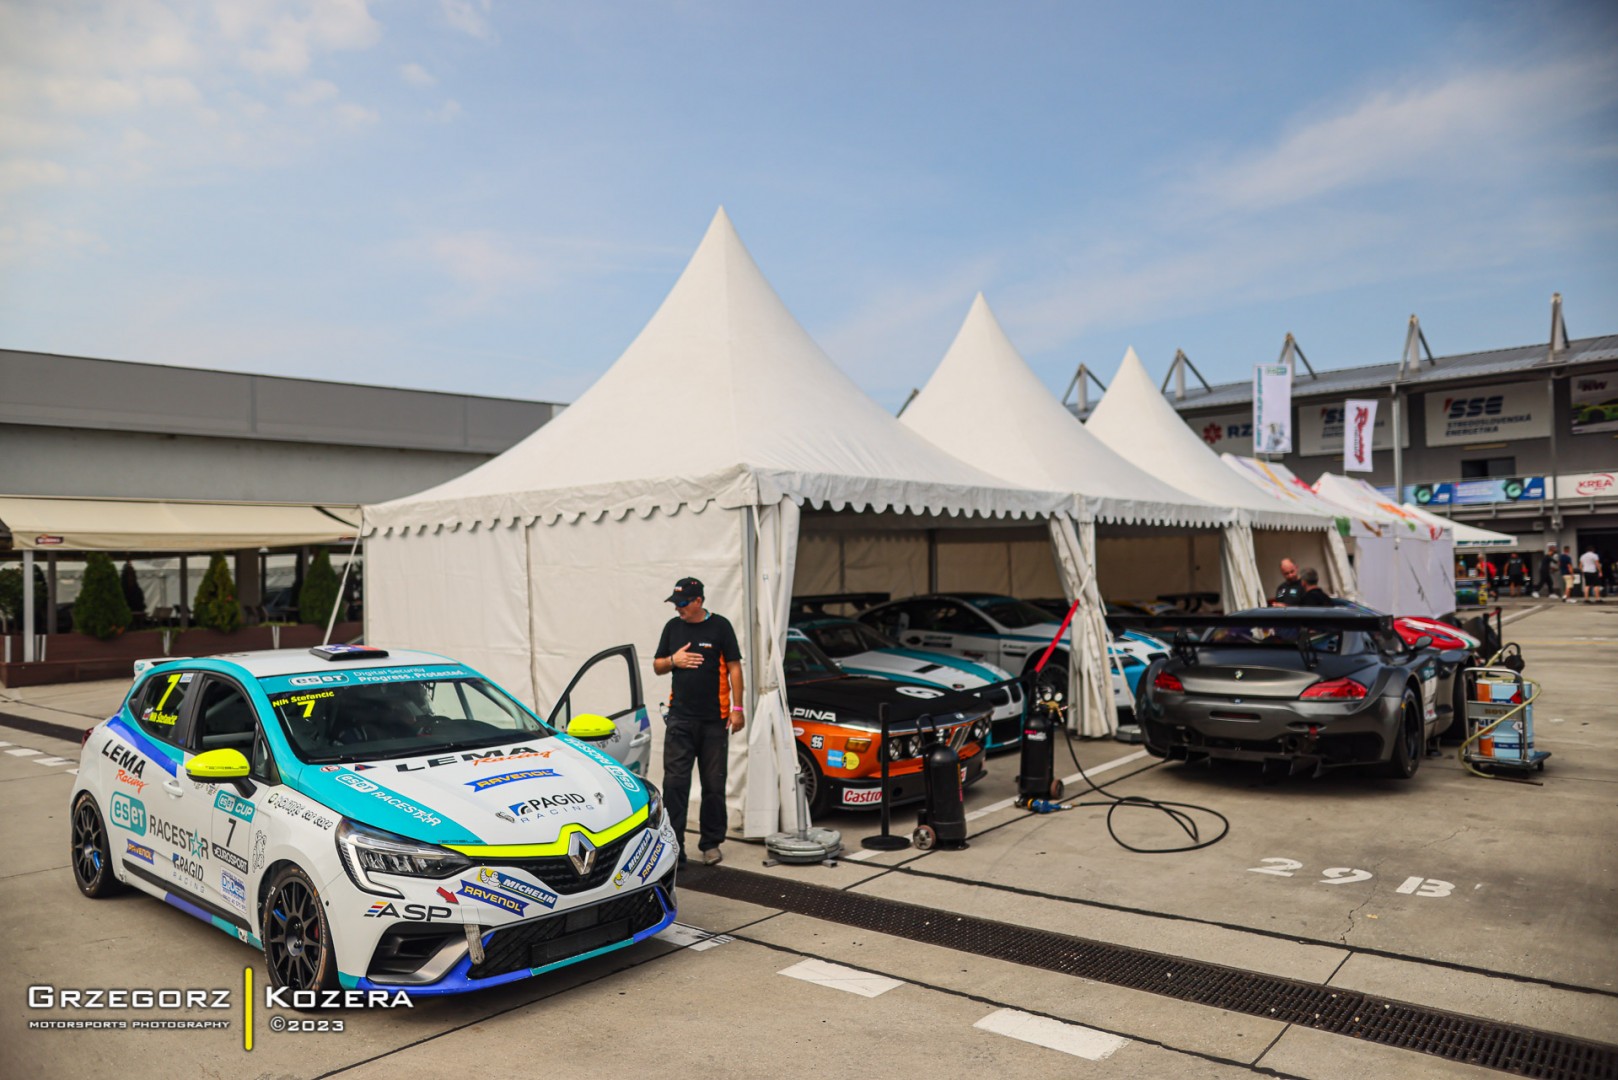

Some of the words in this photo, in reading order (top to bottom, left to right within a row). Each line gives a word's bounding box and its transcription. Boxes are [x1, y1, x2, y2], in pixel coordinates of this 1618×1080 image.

[353, 669, 387, 677] Digital
[155, 673, 182, 711] 7
[272, 698, 289, 708] Nik
[297, 699, 316, 718] 7
[101, 739, 146, 780] LEMA
[395, 746, 541, 772] LEMA
[472, 748, 558, 767] Racing
[115, 768, 149, 795] Racing
[476, 769, 551, 788] RAVENOL
[234, 801, 254, 817] CUP
[520, 804, 595, 823] RACING
[528, 793, 586, 811] PAGID
[113, 799, 146, 830] eset
[227, 817, 237, 848] 7
[179, 856, 205, 882] PAGID
[464, 885, 523, 912] RAVENOL
[502, 878, 556, 905] MICHELIN
[376, 902, 453, 922] ASP
